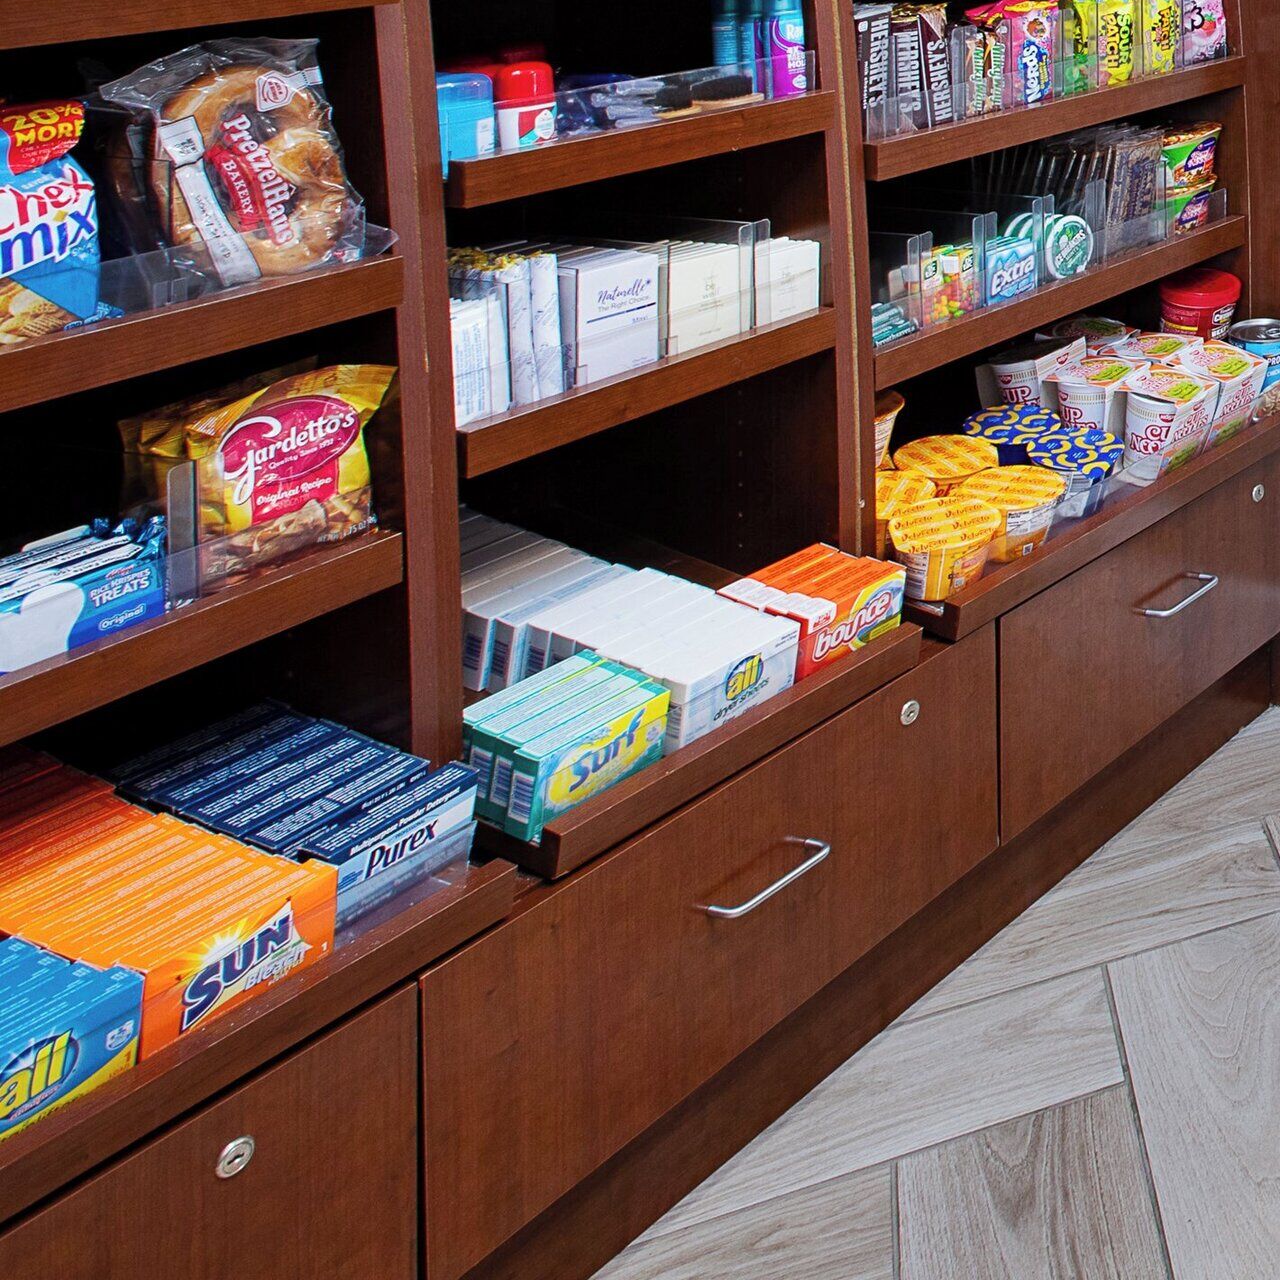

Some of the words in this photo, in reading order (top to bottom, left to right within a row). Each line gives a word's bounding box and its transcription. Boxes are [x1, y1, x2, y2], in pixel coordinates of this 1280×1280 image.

[1102, 12, 1120, 72] PATCH
[1117, 13, 1132, 66] SOUR
[1158, 6, 1171, 51] PATCH
[868, 16, 890, 110] HERSHEY'S
[927, 40, 953, 122] HERSHEY'S
[3, 104, 85, 131] 20%
[15, 119, 85, 147] MORE
[222, 158, 255, 215] BAKERY
[1, 196, 96, 275] mix
[991, 255, 1035, 297] Extra
[1061, 406, 1084, 421] UP
[217, 411, 356, 506] Gardetto's
[256, 484, 301, 506] Original
[301, 477, 333, 493] Recipe
[90, 582, 111, 599] RICE
[92, 577, 151, 609] TREATS
[100, 604, 145, 630] Original
[813, 590, 892, 660] bounce
[726, 654, 762, 702] all
[713, 701, 739, 722] dryer
[569, 708, 646, 793] Surf
[398, 807, 426, 827] Powder
[425, 785, 461, 813] Detergent
[364, 818, 439, 881] Purex
[181, 913, 293, 1033] SUN
[244, 948, 306, 991] Bleach
[0, 1030, 72, 1120] all
